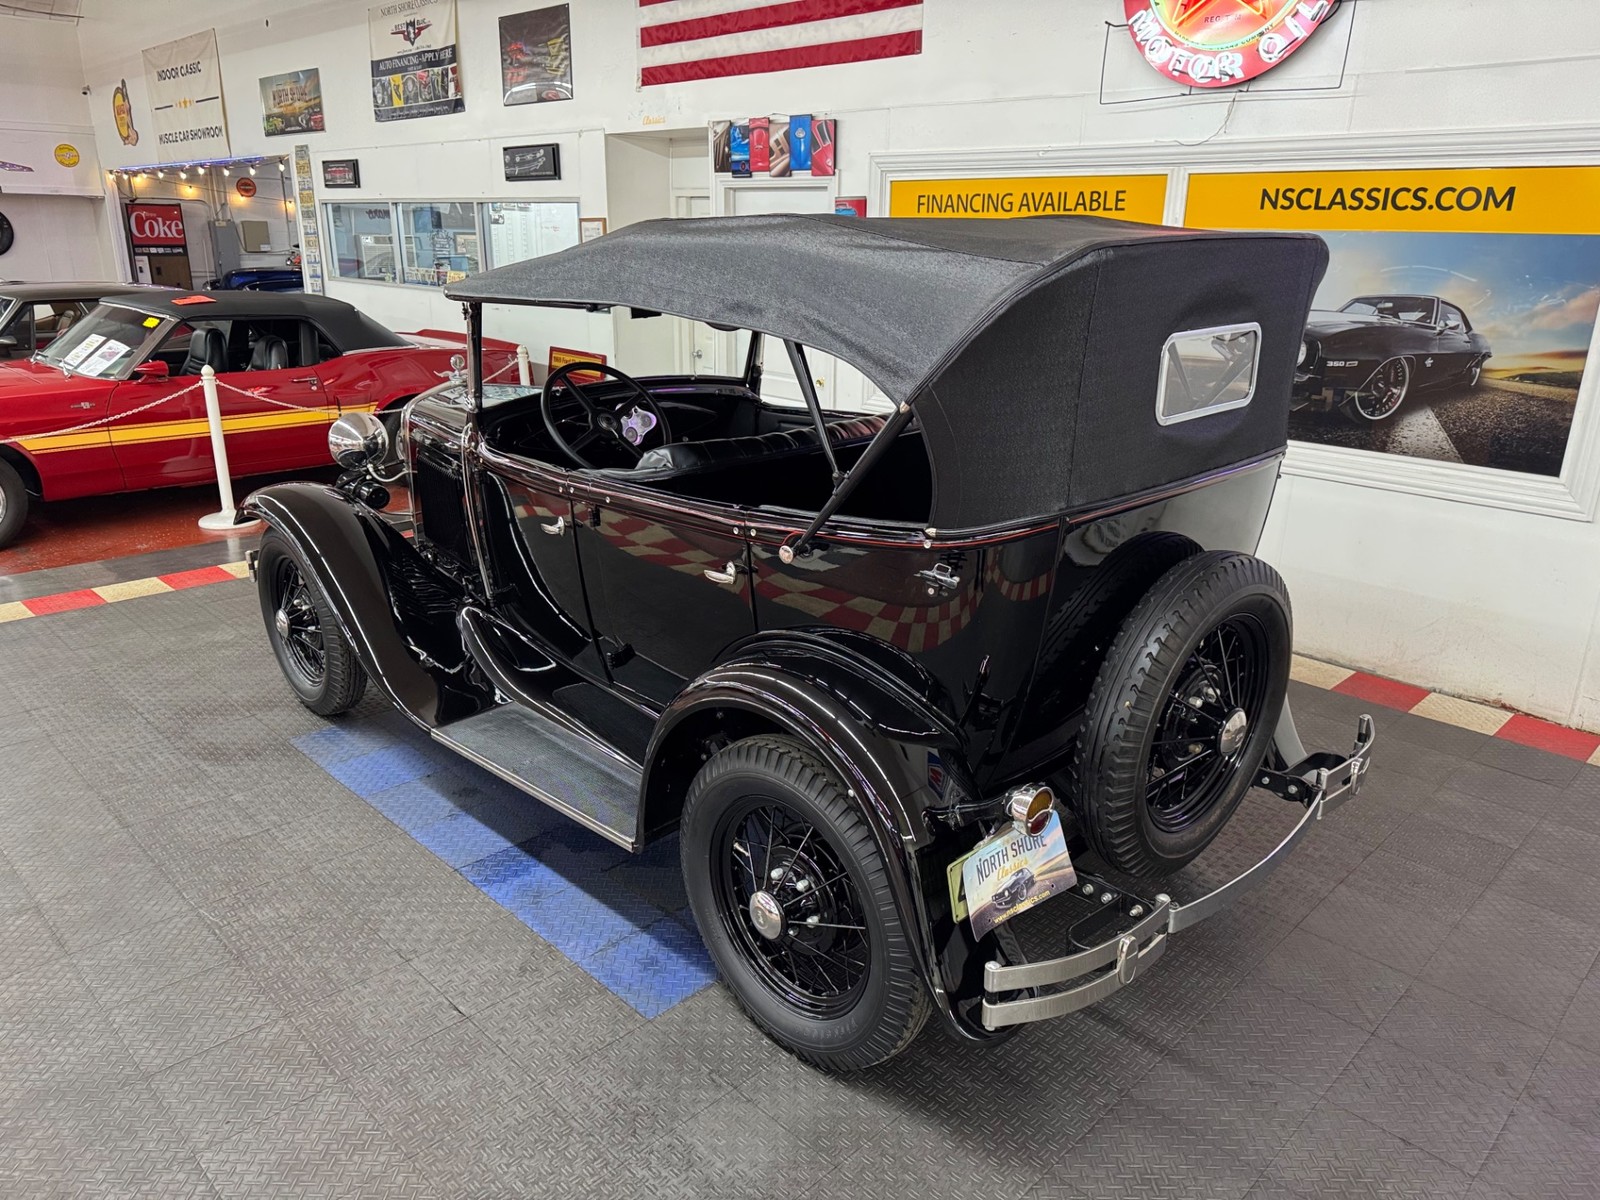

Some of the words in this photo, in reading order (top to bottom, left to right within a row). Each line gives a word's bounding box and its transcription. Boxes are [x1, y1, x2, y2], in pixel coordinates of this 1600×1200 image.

[1128, 9, 1245, 83] MOTOR
[1258, 0, 1329, 63] OIL
[157, 67, 179, 82] INDOOR
[180, 61, 202, 77] CLASSIC
[379, 61, 392, 71] AUTO
[392, 55, 419, 69] FINANCING
[421, 52, 439, 64] APPLY
[439, 48, 453, 60] HERE
[159, 131, 178, 145] MUSCLE
[178, 129, 190, 142] CAR
[189, 125, 223, 141] SHOWROOM
[917, 192, 1014, 214] FINANCING
[1017, 190, 1127, 213] AVAILABLE
[1259, 186, 1516, 212] NSCLASSICS.COM
[130, 211, 184, 239] Coke
[976, 847, 1009, 886] NORTH
[1010, 833, 1048, 858] SHORE
[997, 857, 1029, 882] Classics
